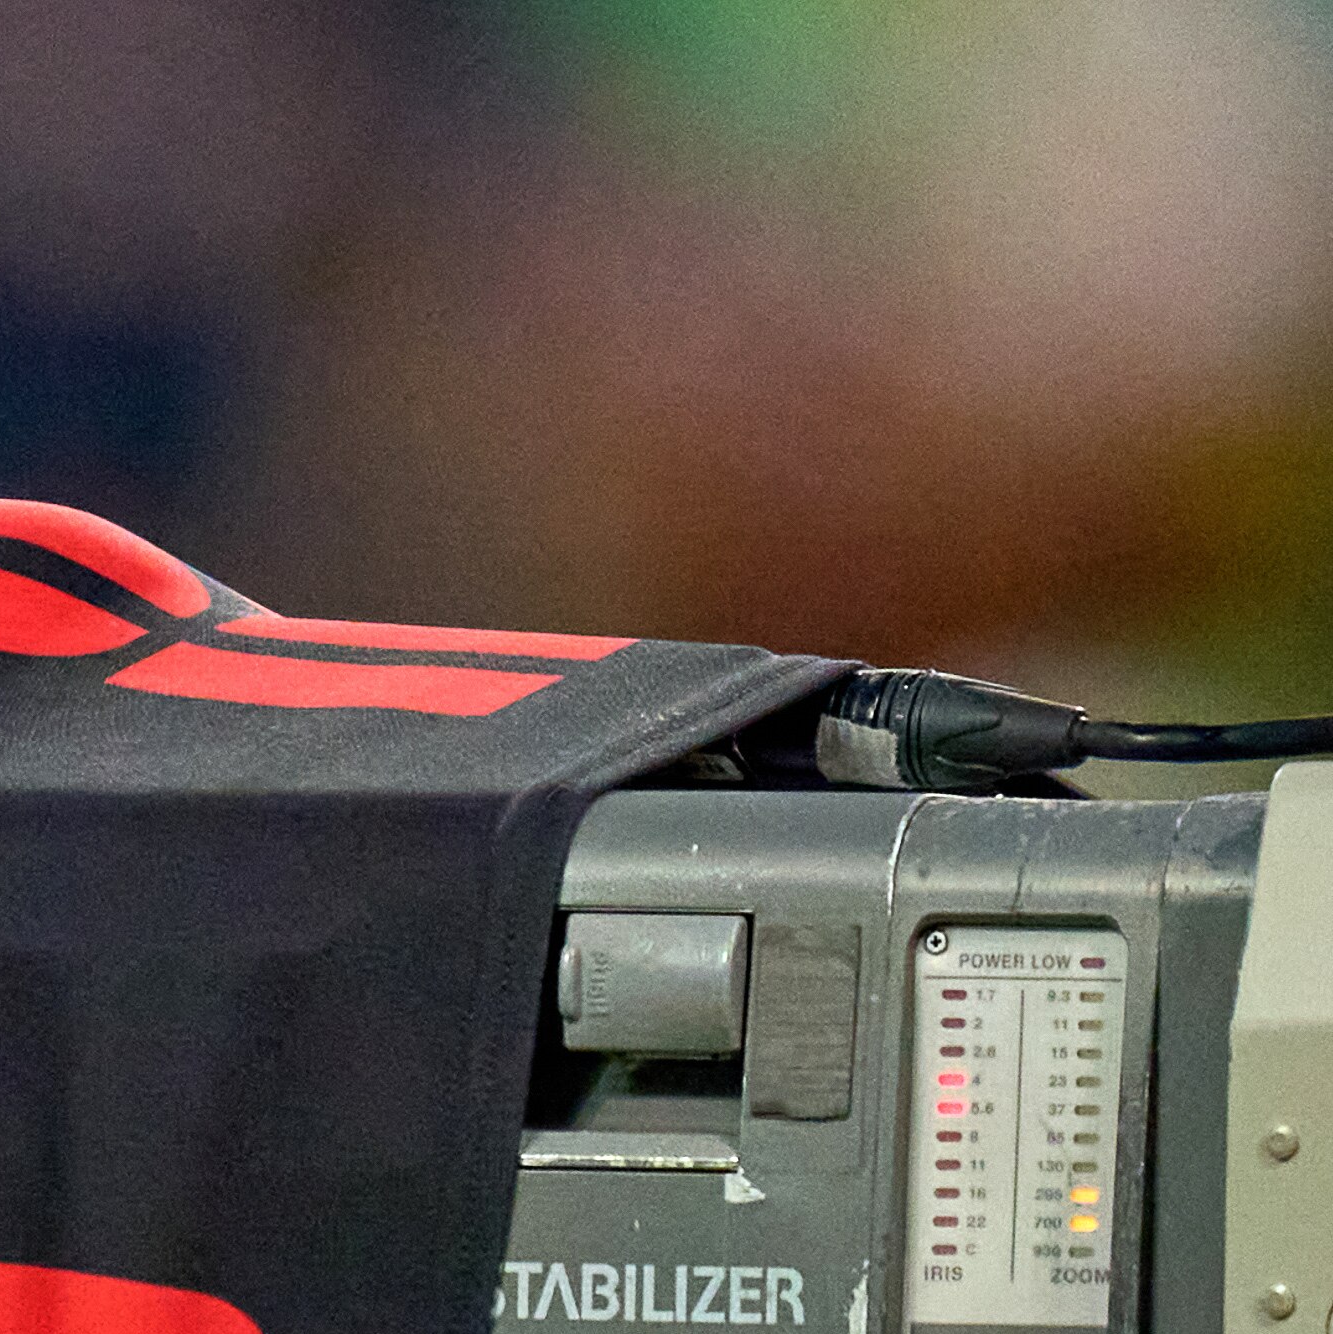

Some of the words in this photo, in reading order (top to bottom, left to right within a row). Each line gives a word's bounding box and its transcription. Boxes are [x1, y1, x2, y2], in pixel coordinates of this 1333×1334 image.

[959, 953, 1025, 969] POWER
[1032, 954, 1071, 970] LOW
[966, 1216, 986, 1228] 22
[923, 1265, 963, 1282] IRIS
[1050, 1267, 1111, 1284] ZOOM
